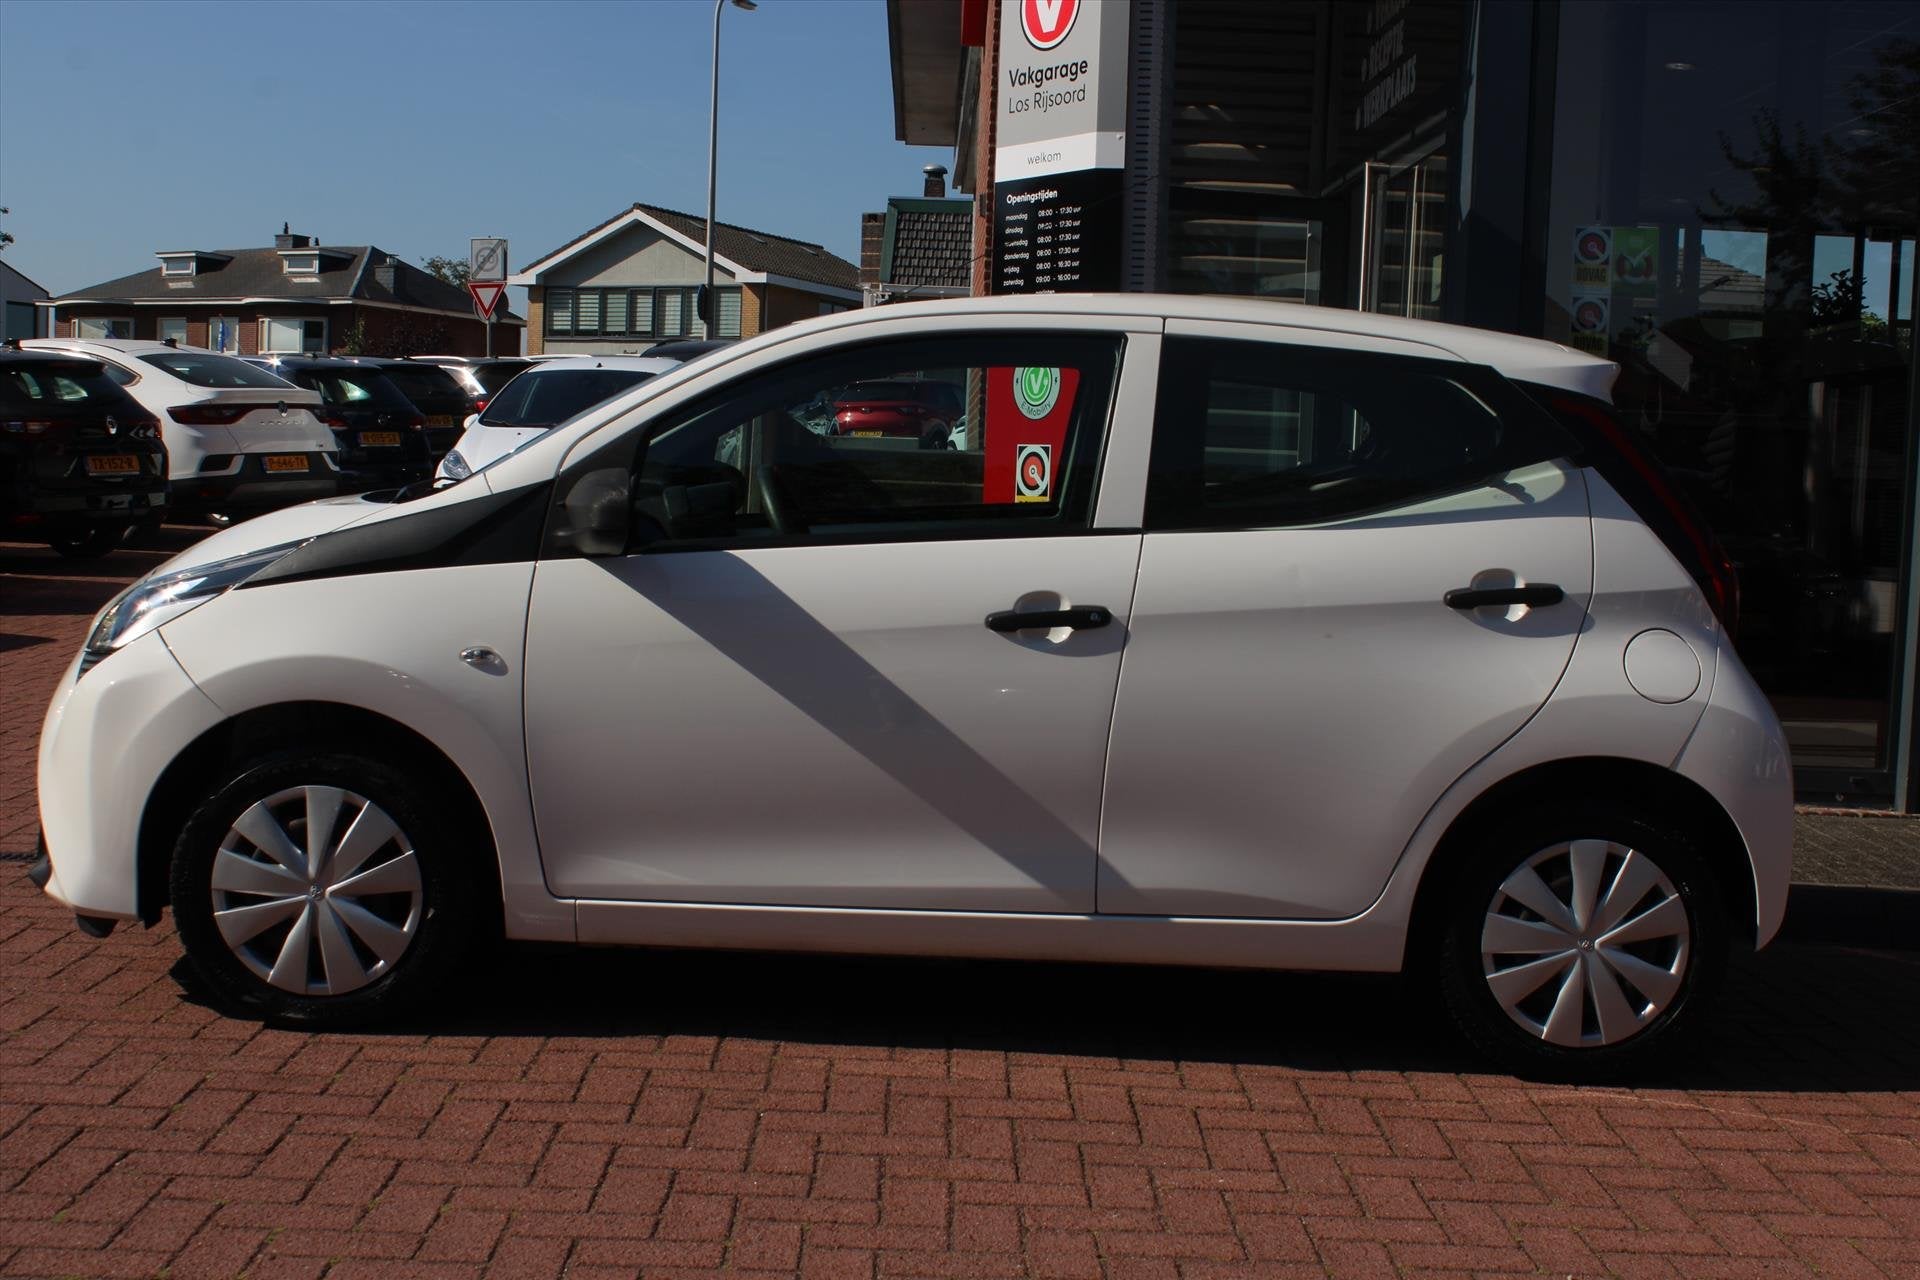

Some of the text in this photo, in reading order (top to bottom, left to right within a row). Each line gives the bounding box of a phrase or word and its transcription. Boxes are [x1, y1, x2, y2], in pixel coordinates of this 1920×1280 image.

[1009, 60, 1089, 88] Vakgarage
[1363, 54, 1417, 128] WERKPLAATS
[1009, 84, 1086, 114] Los Rijsoord
[1027, 151, 1062, 165] welkom
[1006, 189, 1058, 206] Openingstijden
[1005, 212, 1028, 222] maandag
[1038, 208, 1053, 217] 08:00
[1005, 226, 1024, 235] dinsdag
[1037, 235, 1052, 244] 08:00
[1004, 251, 1030, 261] donderdag
[1036, 248, 1052, 257] 08:00
[1003, 265, 1020, 275] vrijdag
[1576, 267, 1607, 283] BOVAG
[1003, 278, 1024, 287] zaterdag
[1071, 273, 1080, 281] uur
[1020, 401, 1051, 417] E-Mobility
